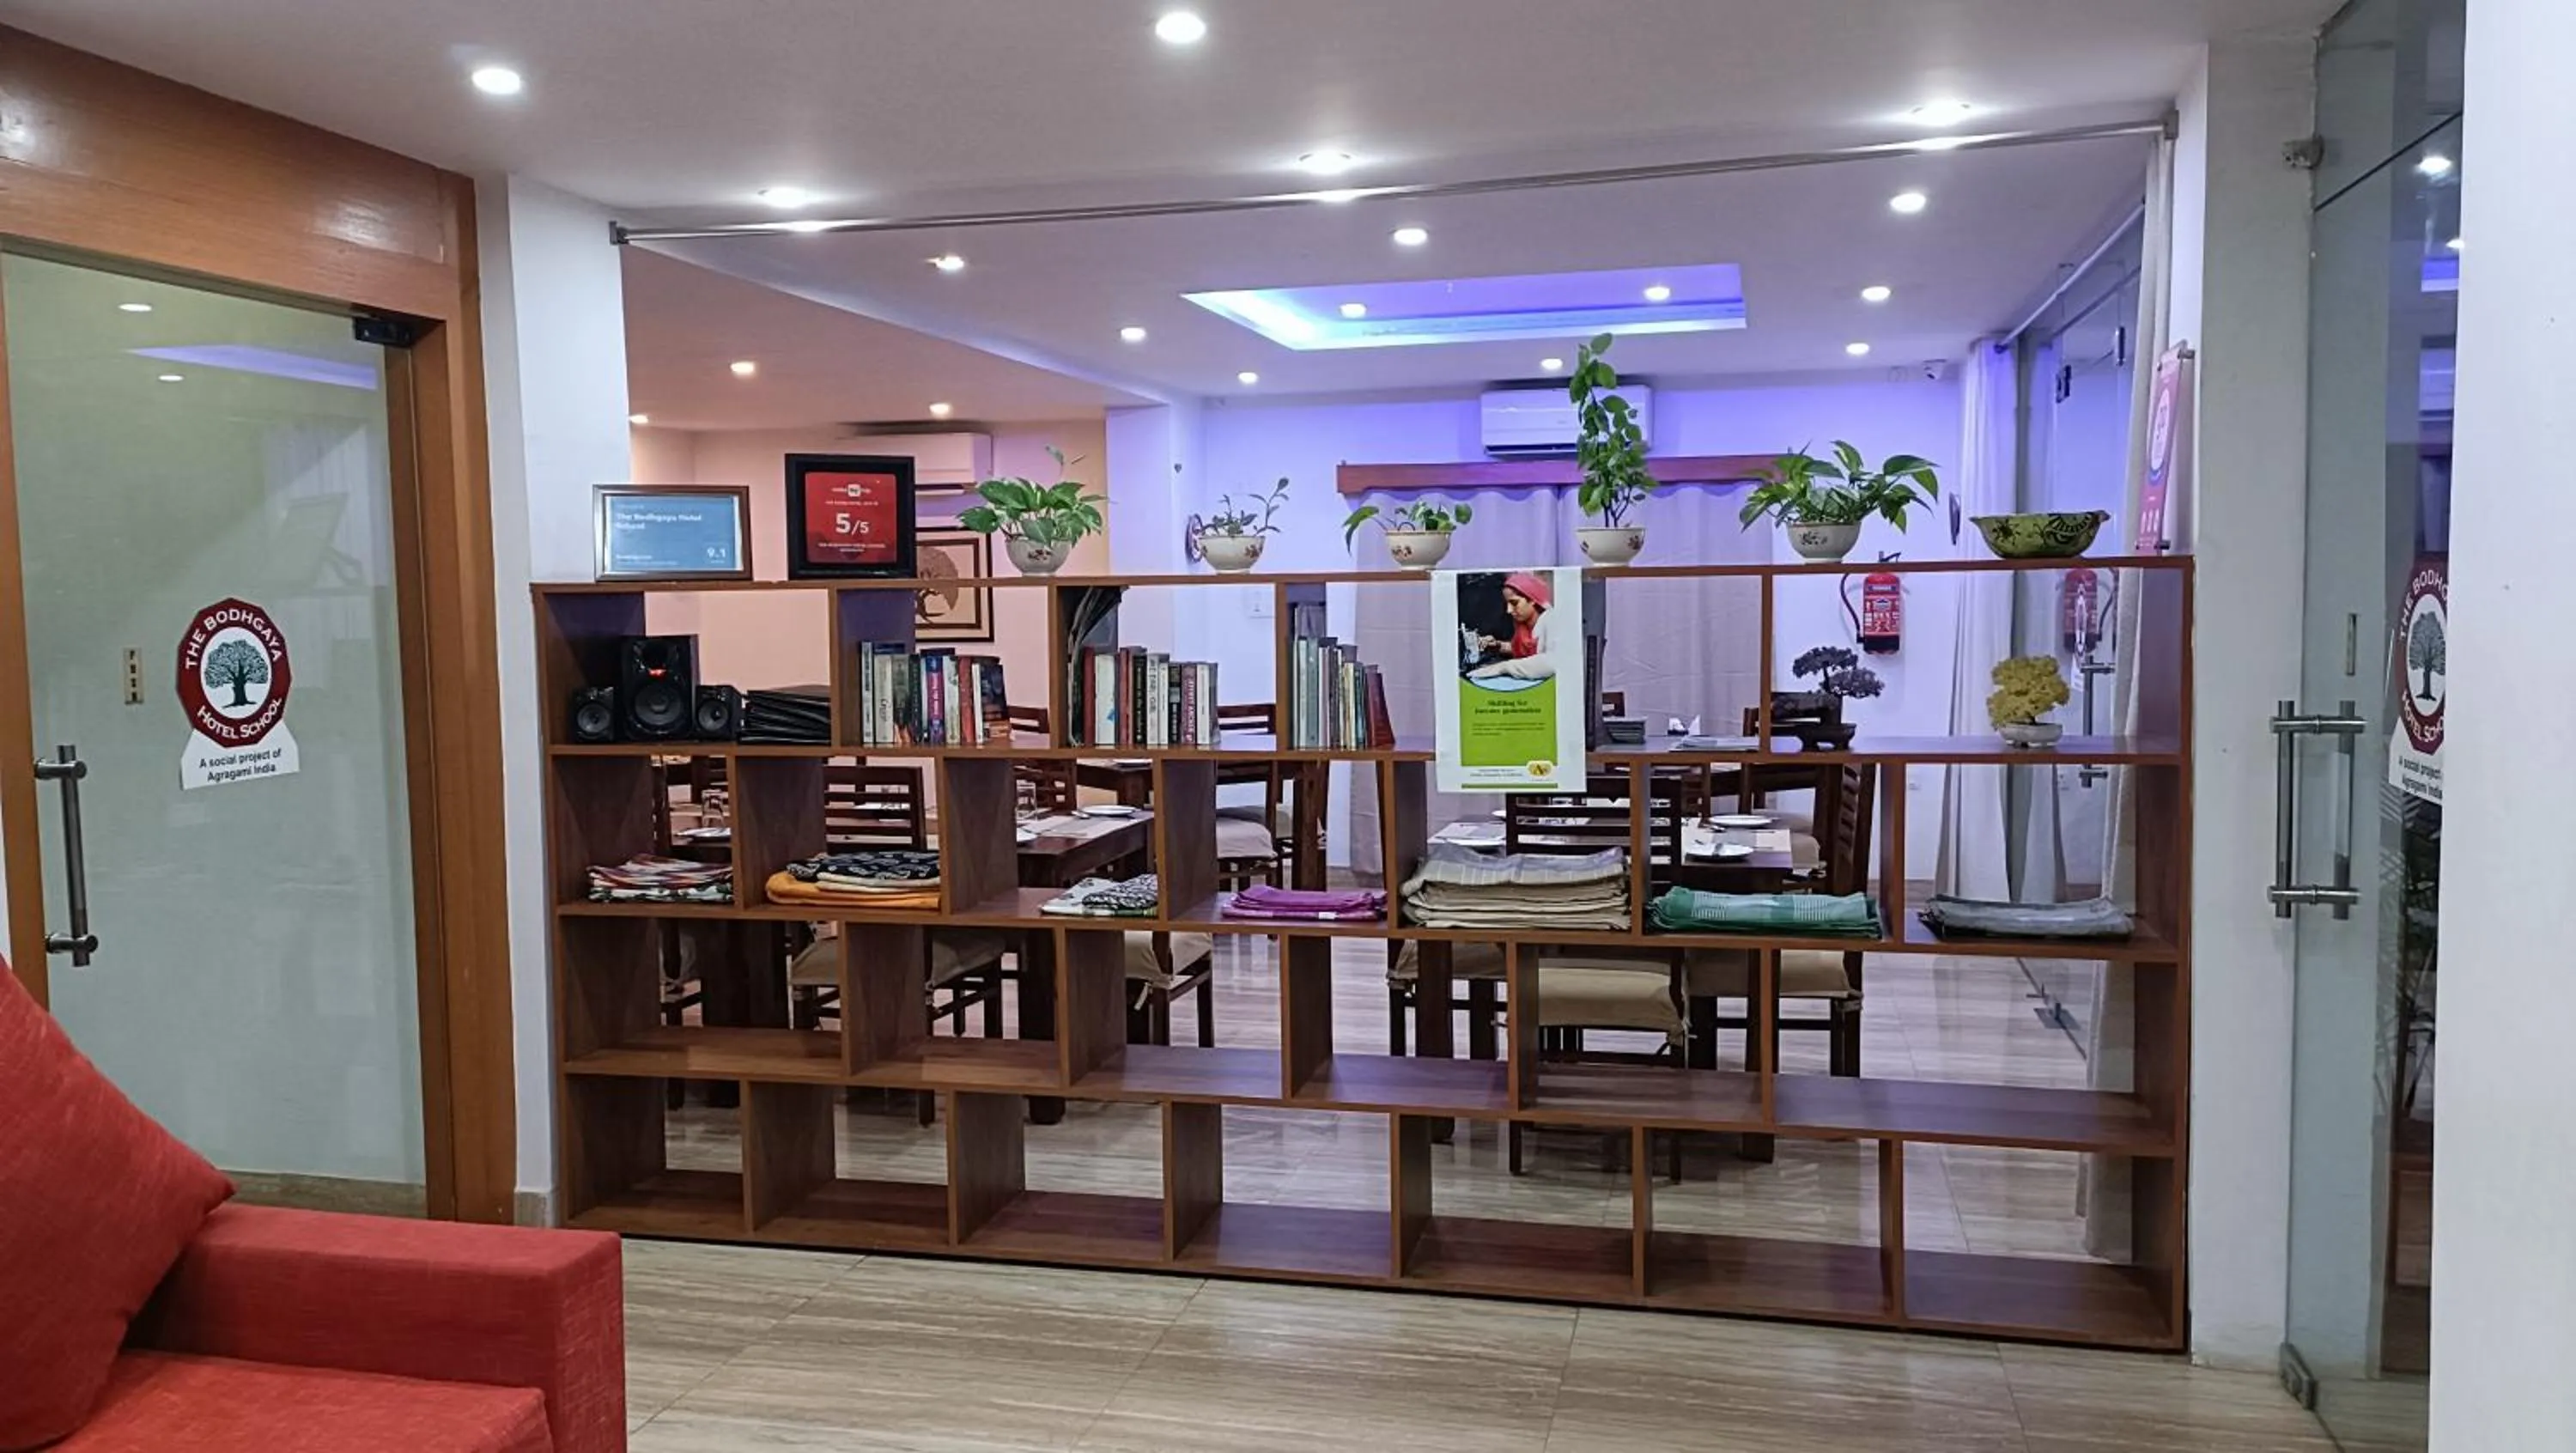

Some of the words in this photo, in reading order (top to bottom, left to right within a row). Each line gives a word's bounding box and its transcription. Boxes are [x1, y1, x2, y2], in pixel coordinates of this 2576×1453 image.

[835, 513, 870, 535] 5/5
[185, 629, 206, 669] THE
[204, 608, 283, 661] BODHGAYA
[197, 705, 240, 739] HOTEL
[240, 696, 283, 739] SCHOOL
[199, 758, 207, 769] A
[209, 755, 237, 767] social
[239, 750, 270, 765] project
[272, 749, 282, 758] of
[207, 765, 252, 783] Agragami
[254, 763, 276, 774] India
